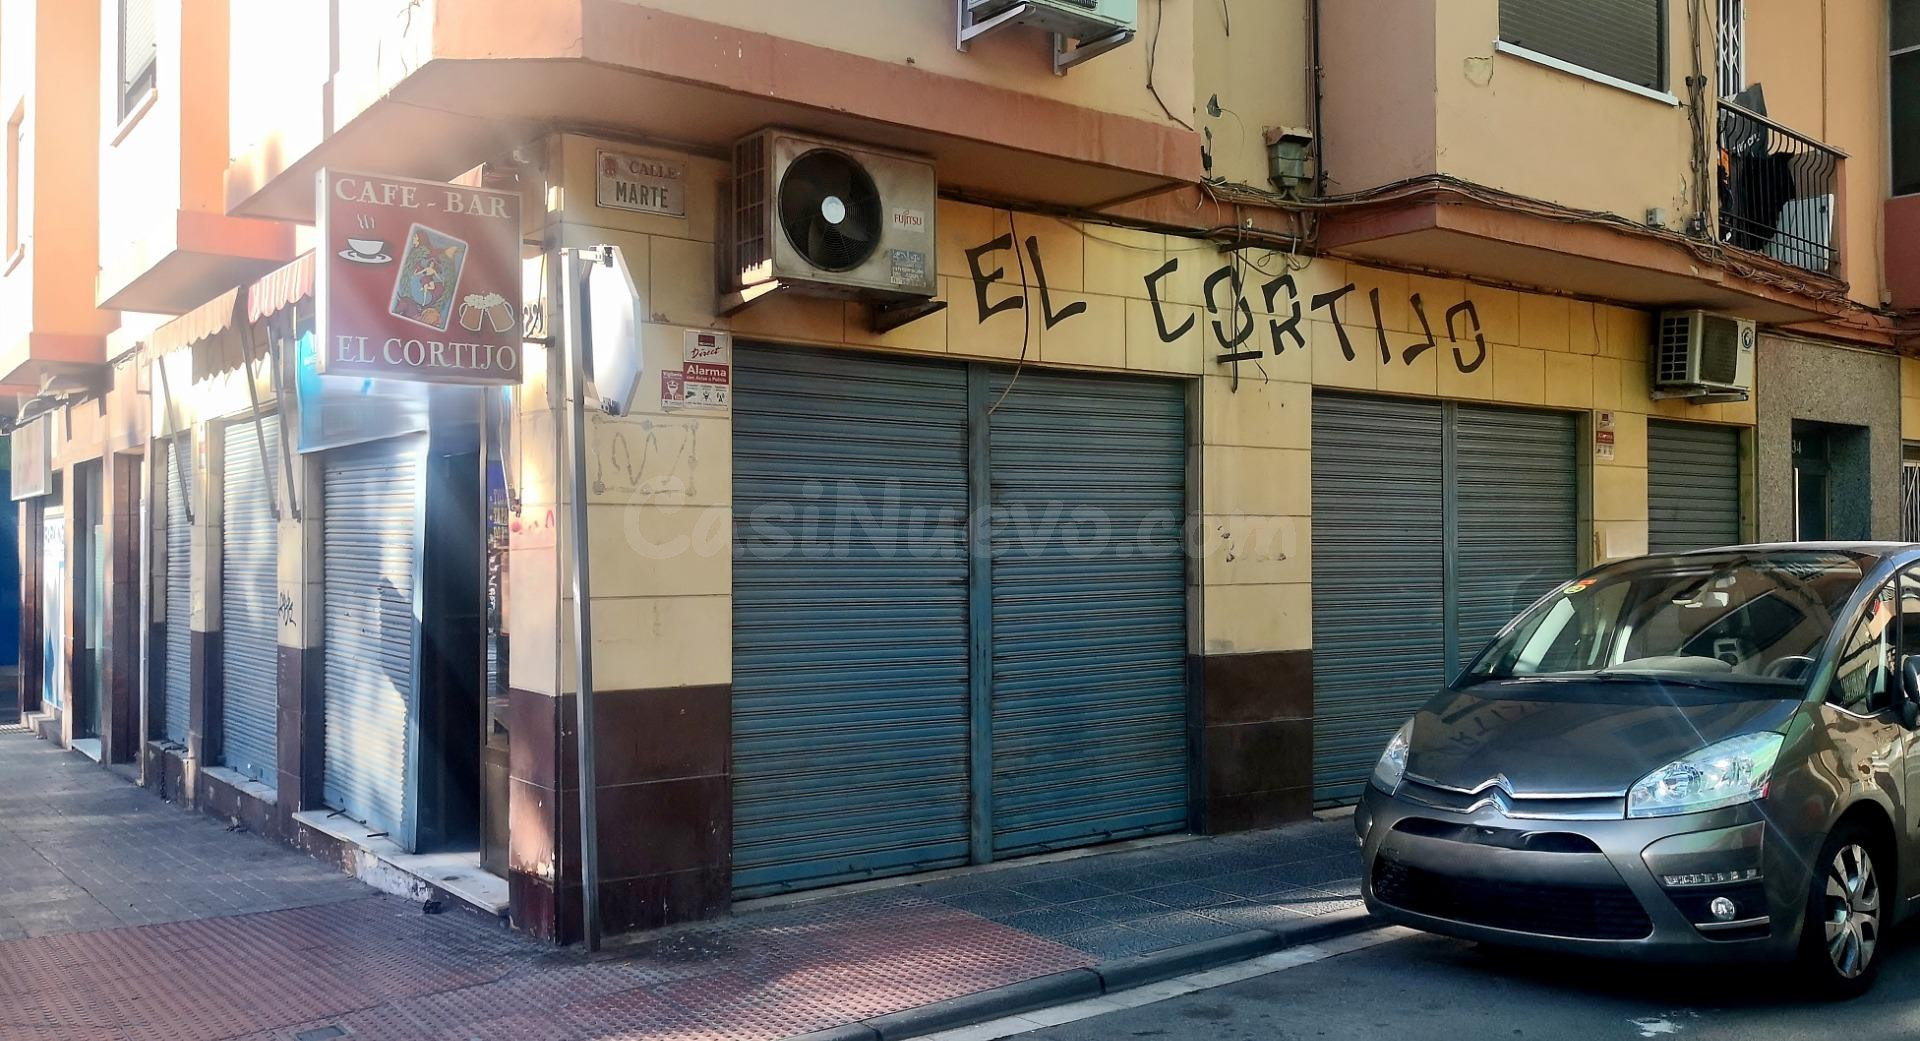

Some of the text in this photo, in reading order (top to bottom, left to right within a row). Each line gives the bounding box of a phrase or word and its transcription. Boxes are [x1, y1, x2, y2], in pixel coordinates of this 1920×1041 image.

[629, 160, 680, 179] CALLE
[335, 178, 420, 209] CAFE
[444, 191, 511, 219] BAR
[616, 181, 669, 208] MARTE
[894, 211, 922, 228] FUJITSU
[964, 233, 1487, 374] EL CORTIJO
[335, 335, 517, 371] EL CORTIJO
[686, 365, 727, 377] Alarma
